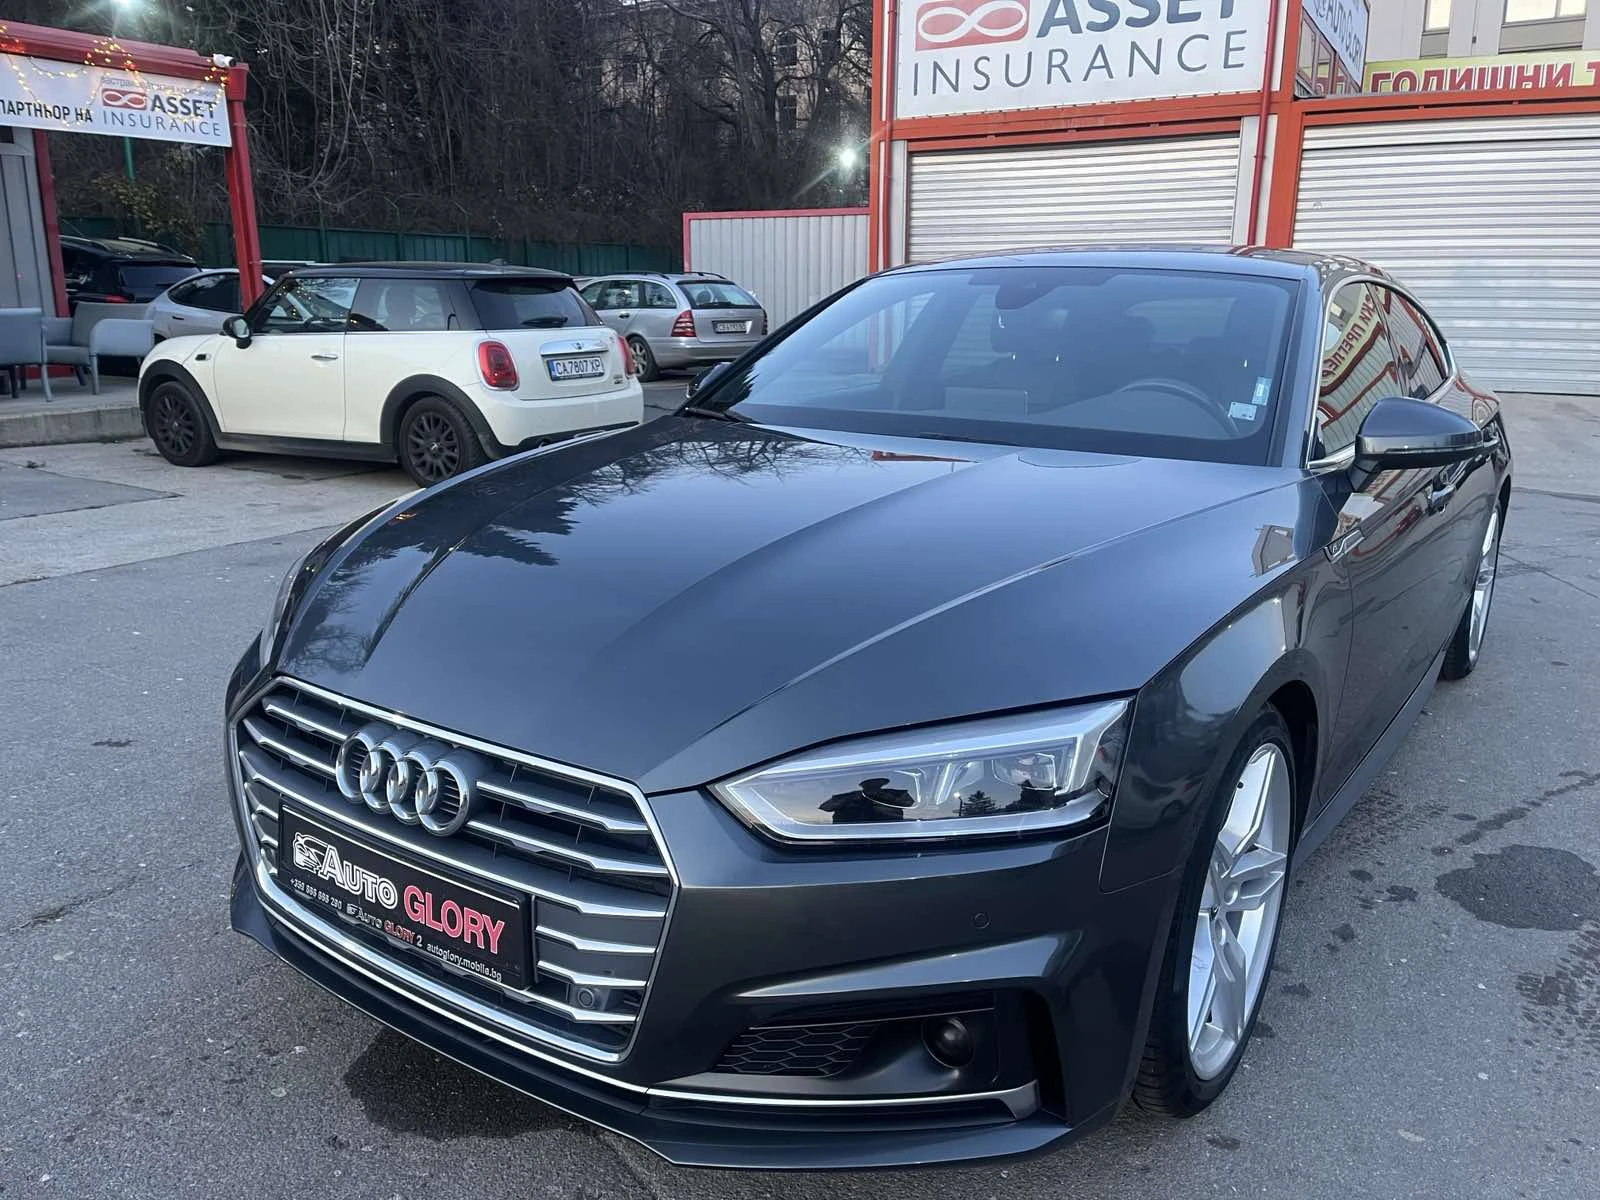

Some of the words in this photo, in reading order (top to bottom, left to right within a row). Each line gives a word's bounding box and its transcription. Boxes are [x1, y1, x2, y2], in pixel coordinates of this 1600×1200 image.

[914, 30, 1247, 96] INSURANCE
[75, 108, 93, 122] НА
[151, 95, 217, 119] ASSET
[103, 110, 221, 136] INSURANCE
[383, 920, 416, 944] GLORY
[416, 935, 423, 947] 2
[403, 885, 505, 955] GLORY
[426, 943, 502, 983] autoglory.mobile.bg
